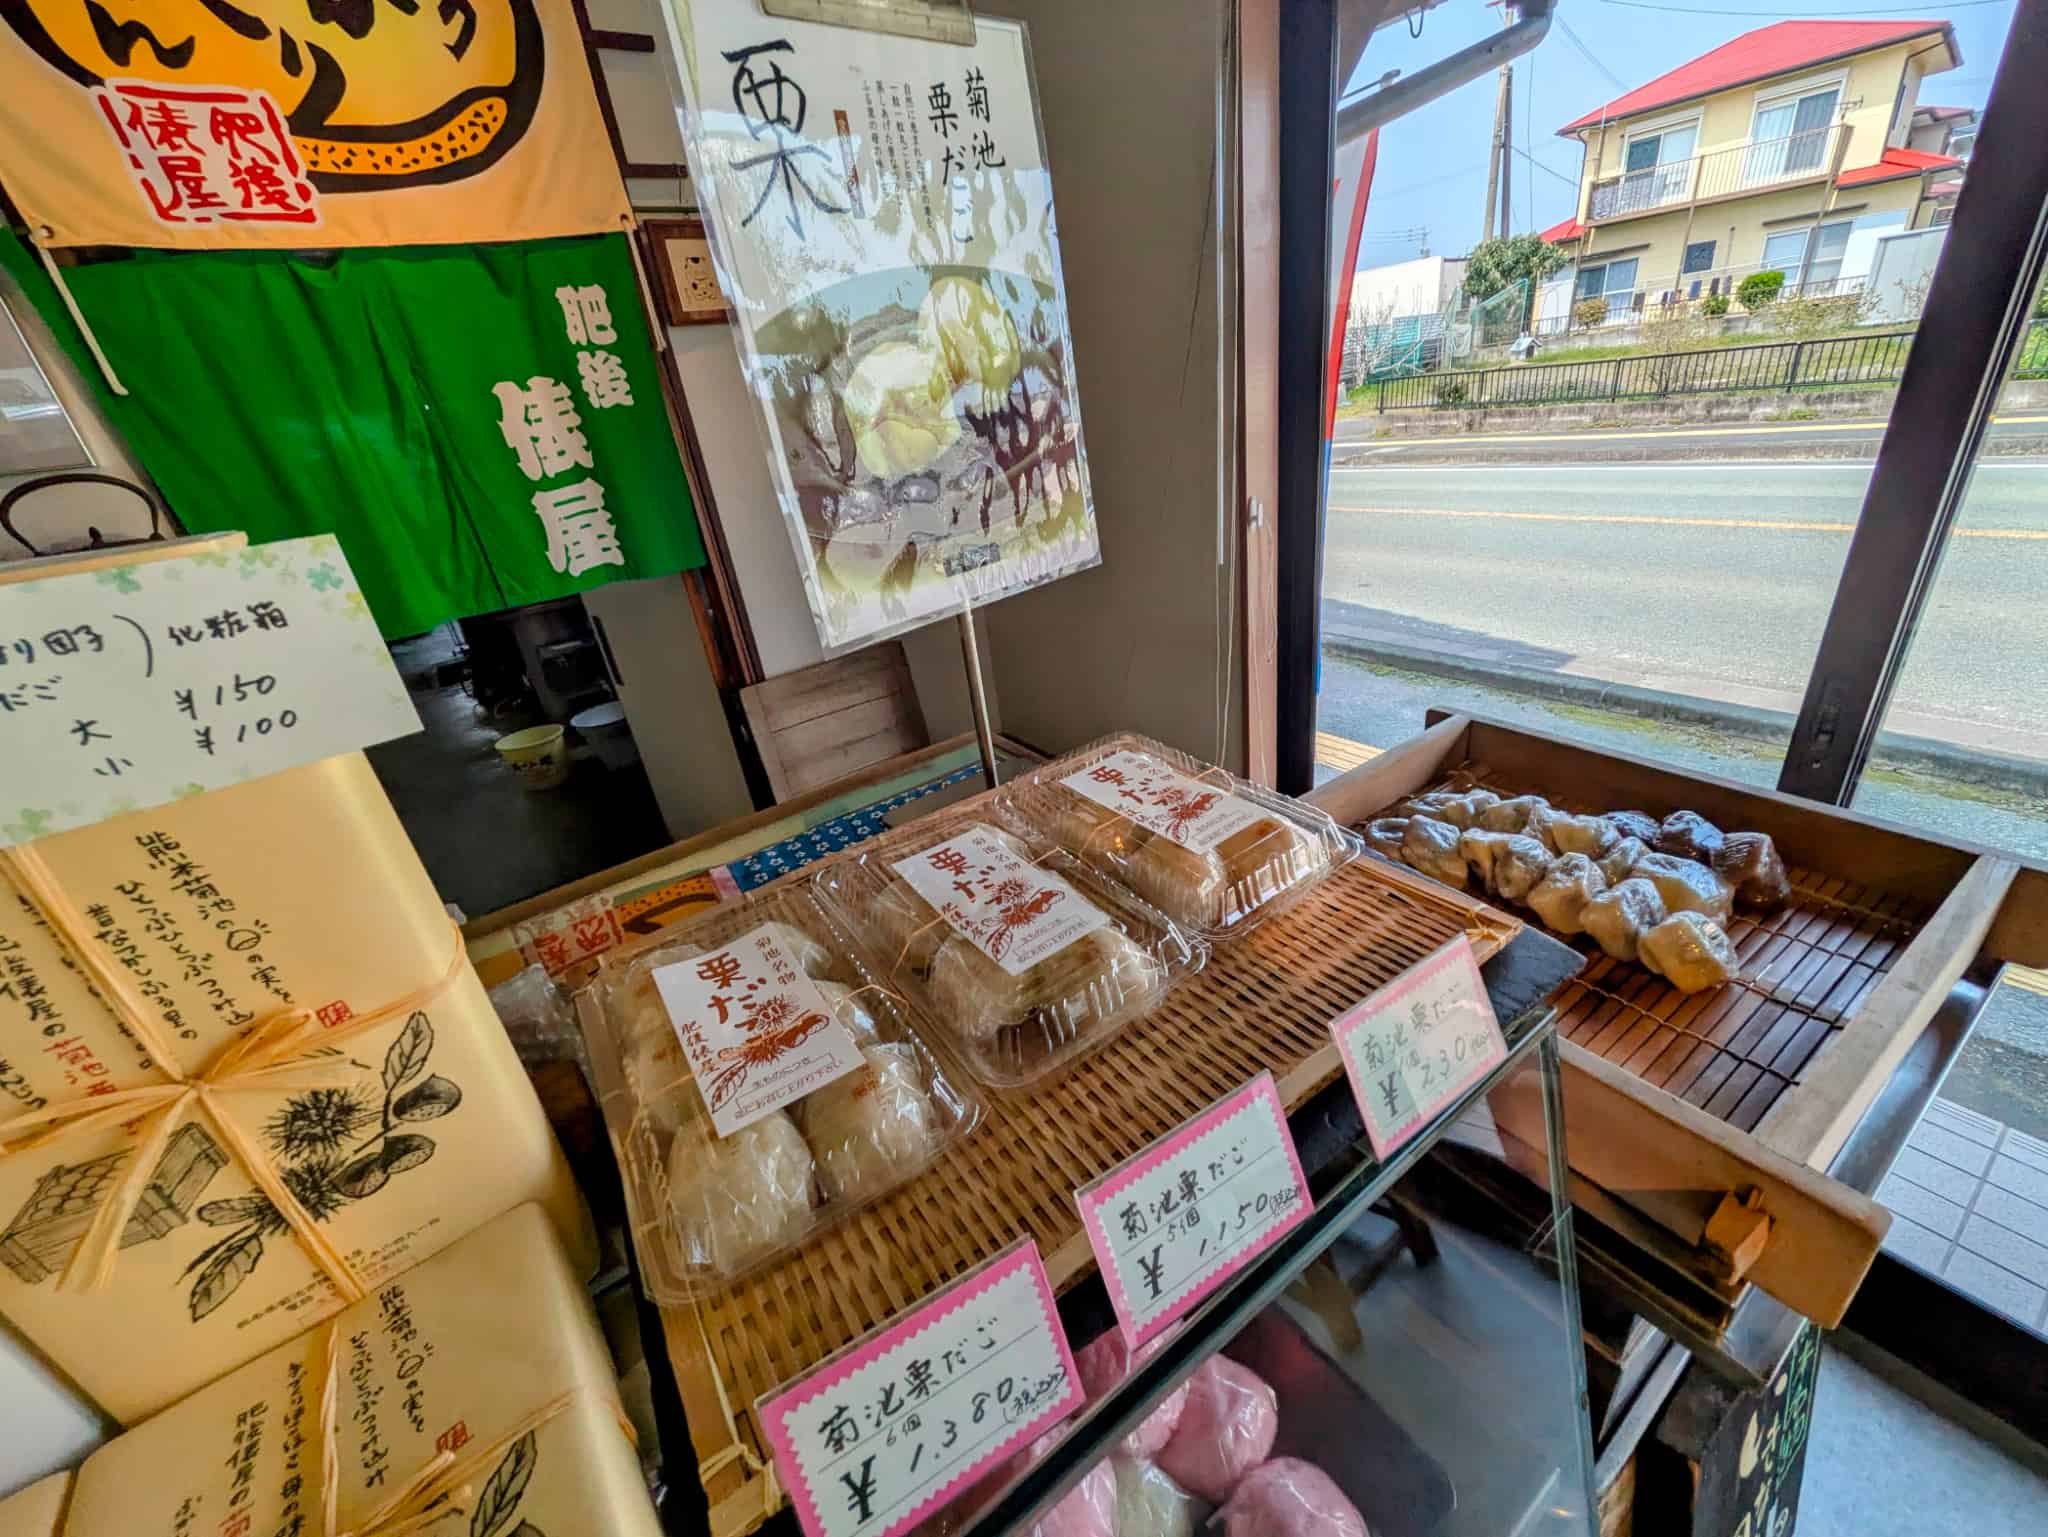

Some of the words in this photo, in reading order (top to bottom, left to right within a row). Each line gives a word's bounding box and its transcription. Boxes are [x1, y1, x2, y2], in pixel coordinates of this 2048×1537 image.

[122, 98, 230, 212] 俵屋
[209, 106, 301, 211] 肥後
[964, 65, 1006, 171] 菊池
[555, 284, 634, 408] 肥後
[491, 376, 625, 577] 俵屋
[168, 601, 289, 646] 化粧箱
[70, 719, 112, 746] 大
[93, 757, 134, 775] 小
[1120, 1136, 1248, 1241] 菊池栗だご
[818, 1317, 998, 1454] 菊池栗だご
